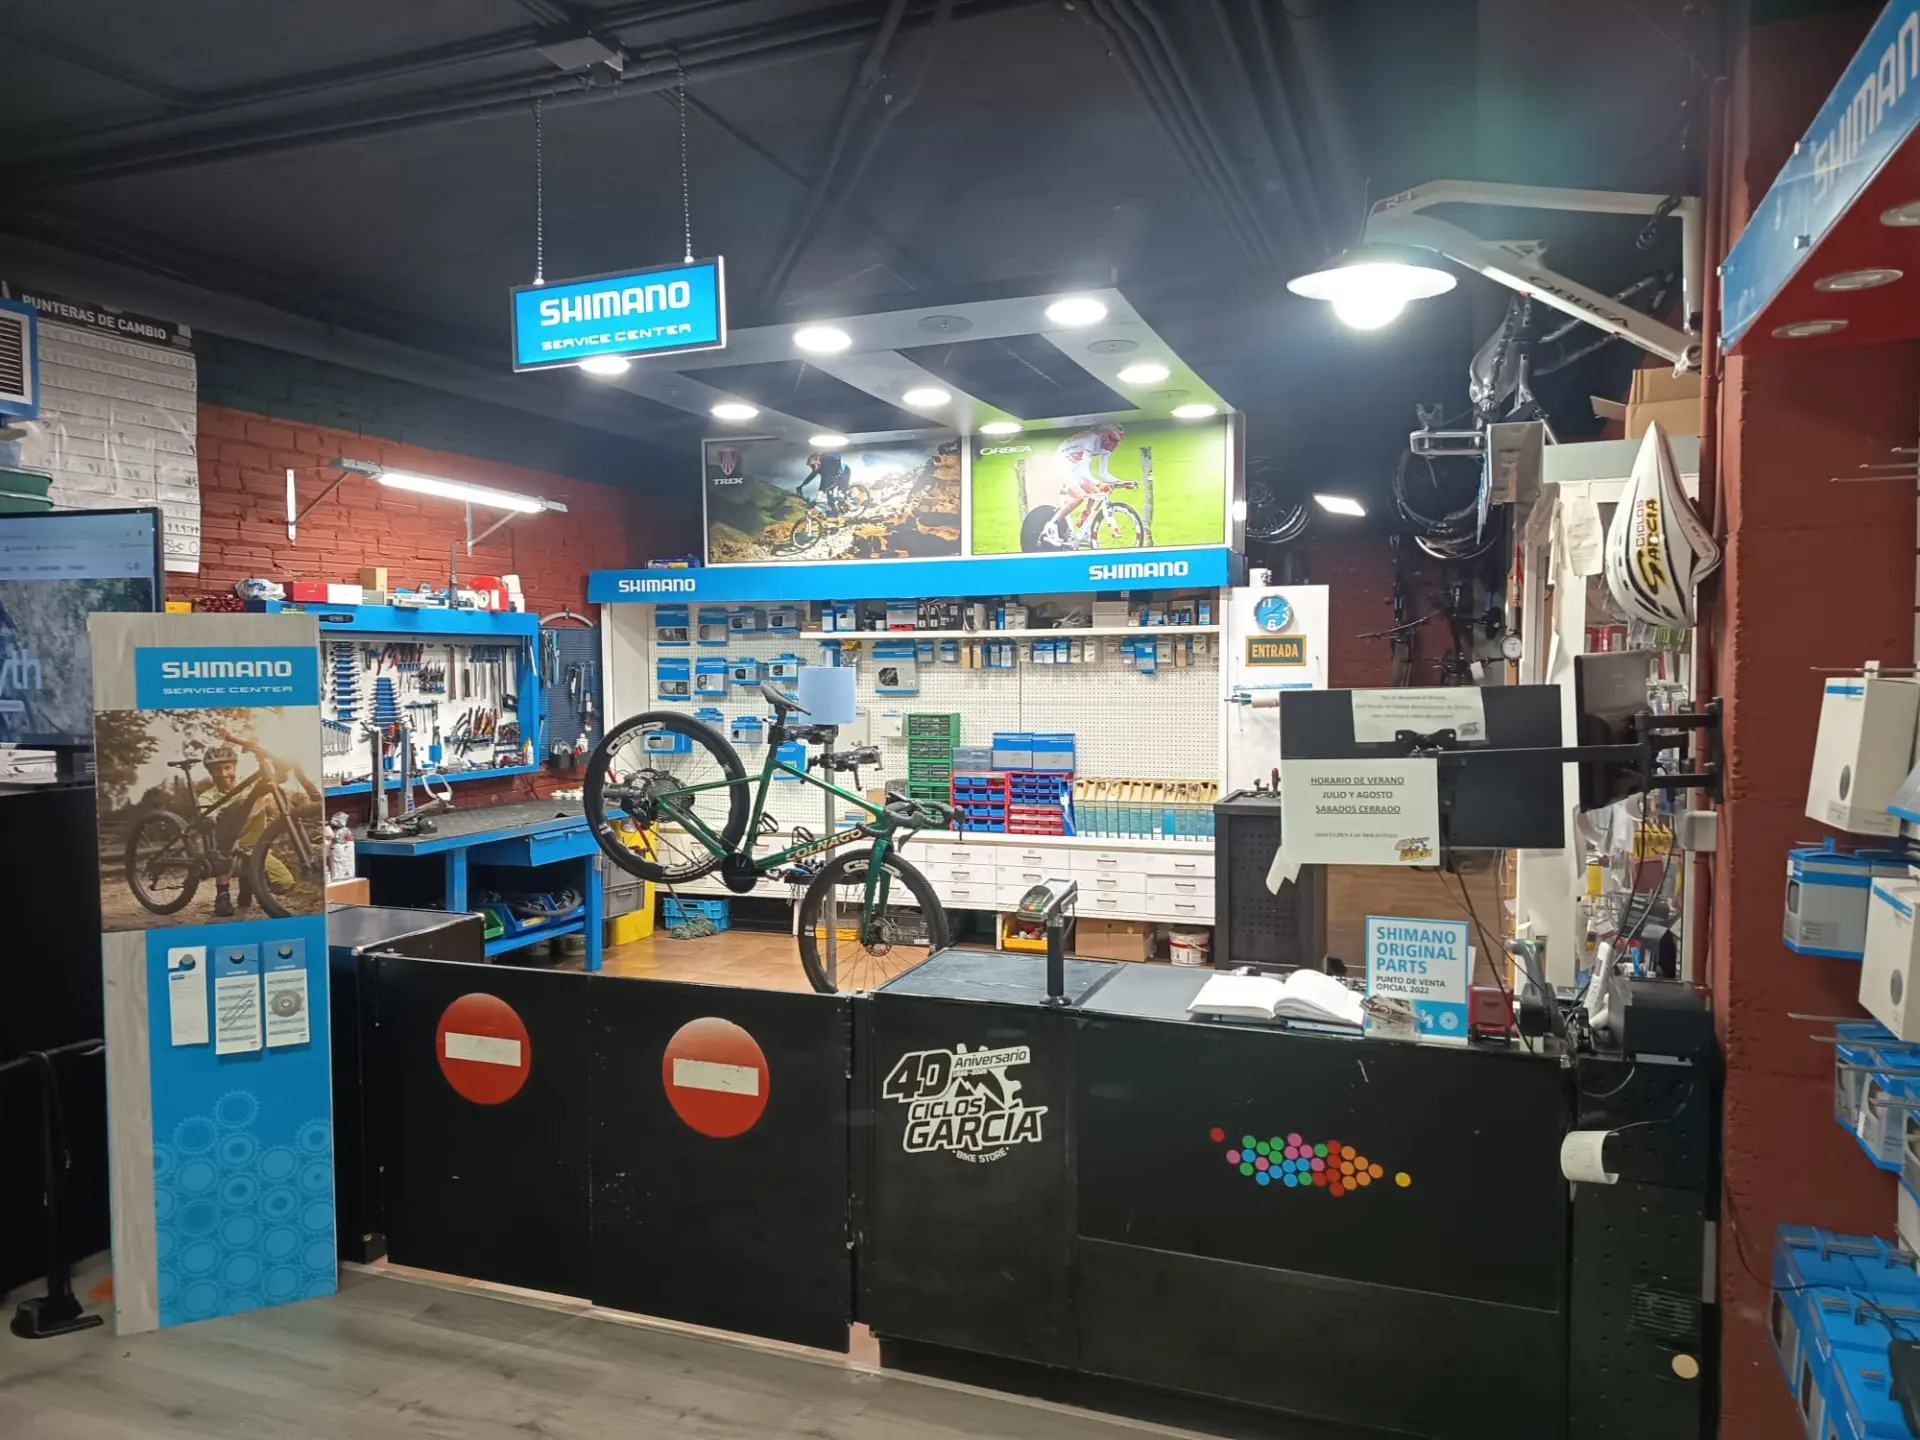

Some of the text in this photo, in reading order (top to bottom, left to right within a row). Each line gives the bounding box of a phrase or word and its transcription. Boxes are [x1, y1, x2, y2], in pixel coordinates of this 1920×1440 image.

[540, 280, 690, 327] SHIMANO
[23, 294, 167, 341] PUNTERAS DE CAMBIO
[541, 323, 692, 351] SERVICE CENTER
[980, 445, 1032, 456] ORBEA
[712, 477, 744, 485] TREK
[1636, 500, 1645, 547] CICLOS
[1088, 560, 1189, 581] SHIMANO
[618, 578, 696, 593] SHIMANO
[1252, 643, 1299, 658] ENTRADA
[161, 660, 292, 679] SHIMANO
[163, 685, 293, 695] SERVICE CENTER
[1310, 776, 1405, 785] HORARIO DE VERANO
[1322, 791, 1393, 799] JULIO Y AGOSTO
[1315, 805, 1401, 814] SABADOS CERRADO
[785, 829, 862, 861] COLNAGO
[1376, 926, 1457, 945] SHIMANO
[1376, 942, 1458, 961] ORIGINAL
[1376, 957, 1428, 975] PARTS
[1376, 975, 1447, 987] PUNTO DE VENTA
[1376, 983, 1430, 995] OFICIAL 2022
[882, 1048, 1028, 1103] 40 Aniversario
[911, 1099, 982, 1121] CICLOS
[956, 1147, 1007, 1164] BIKE STORE
